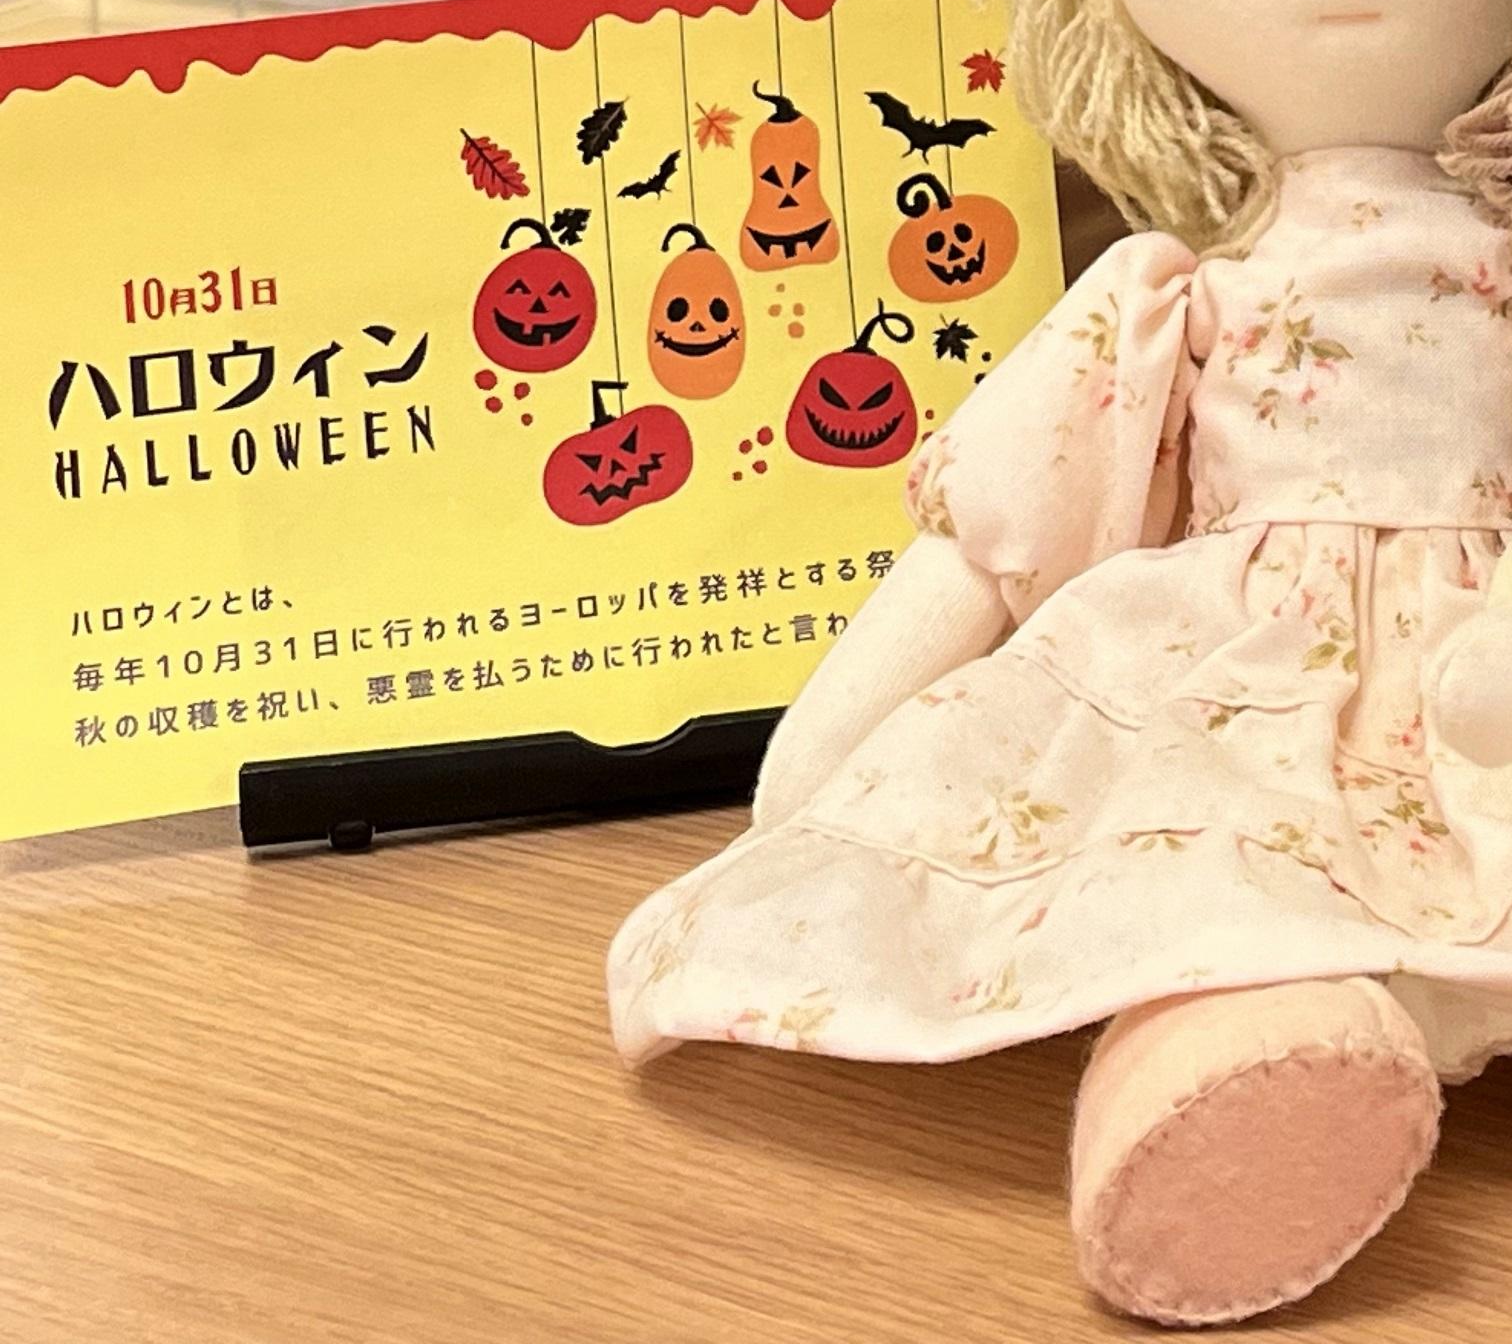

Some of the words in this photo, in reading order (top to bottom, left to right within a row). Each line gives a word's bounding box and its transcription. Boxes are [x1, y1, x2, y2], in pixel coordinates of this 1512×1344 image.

[123, 266, 277, 324] 10月31日
[49, 324, 429, 431] ハロウィン
[55, 405, 435, 500] HALLOWEEN
[71, 585, 294, 637] ハロウィンとは、
